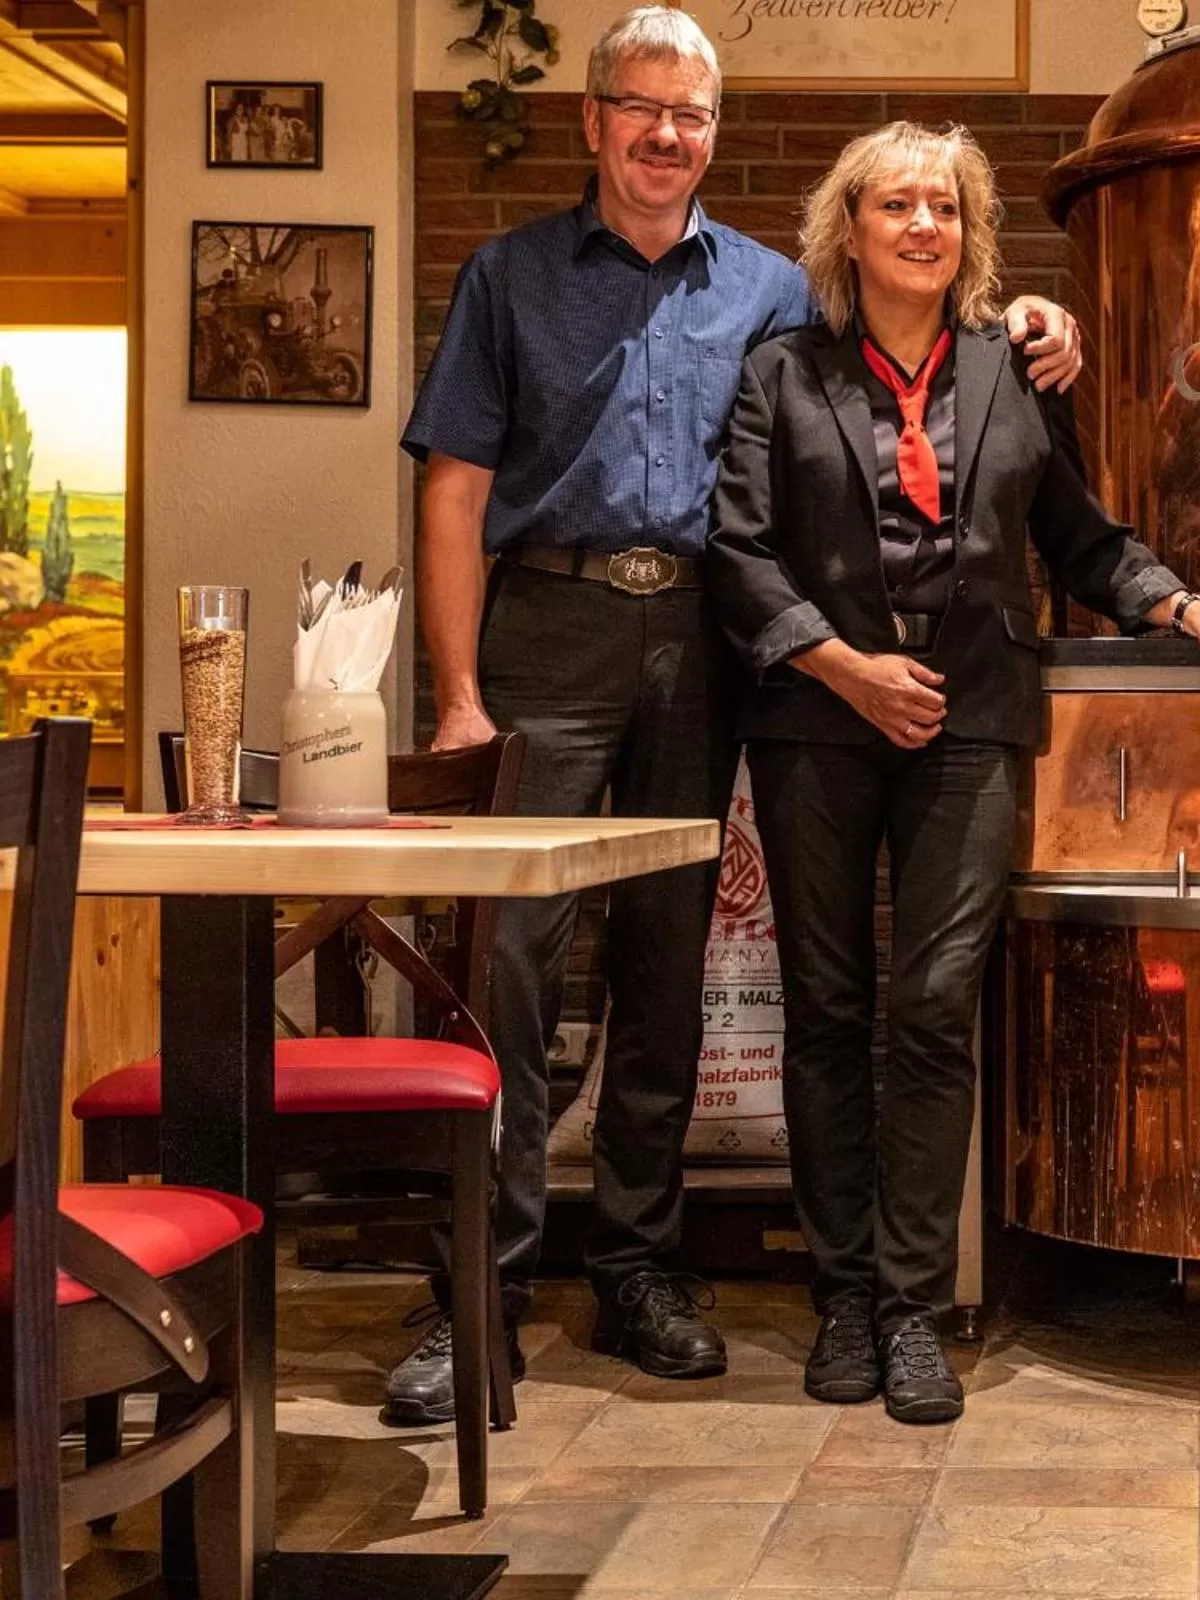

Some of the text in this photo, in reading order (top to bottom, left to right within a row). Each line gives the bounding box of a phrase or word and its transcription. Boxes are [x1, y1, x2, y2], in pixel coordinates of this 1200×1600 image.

[303, 741, 363, 764] Landbier
[721, 1012, 734, 1028] 2
[740, 1044, 775, 1060] und
